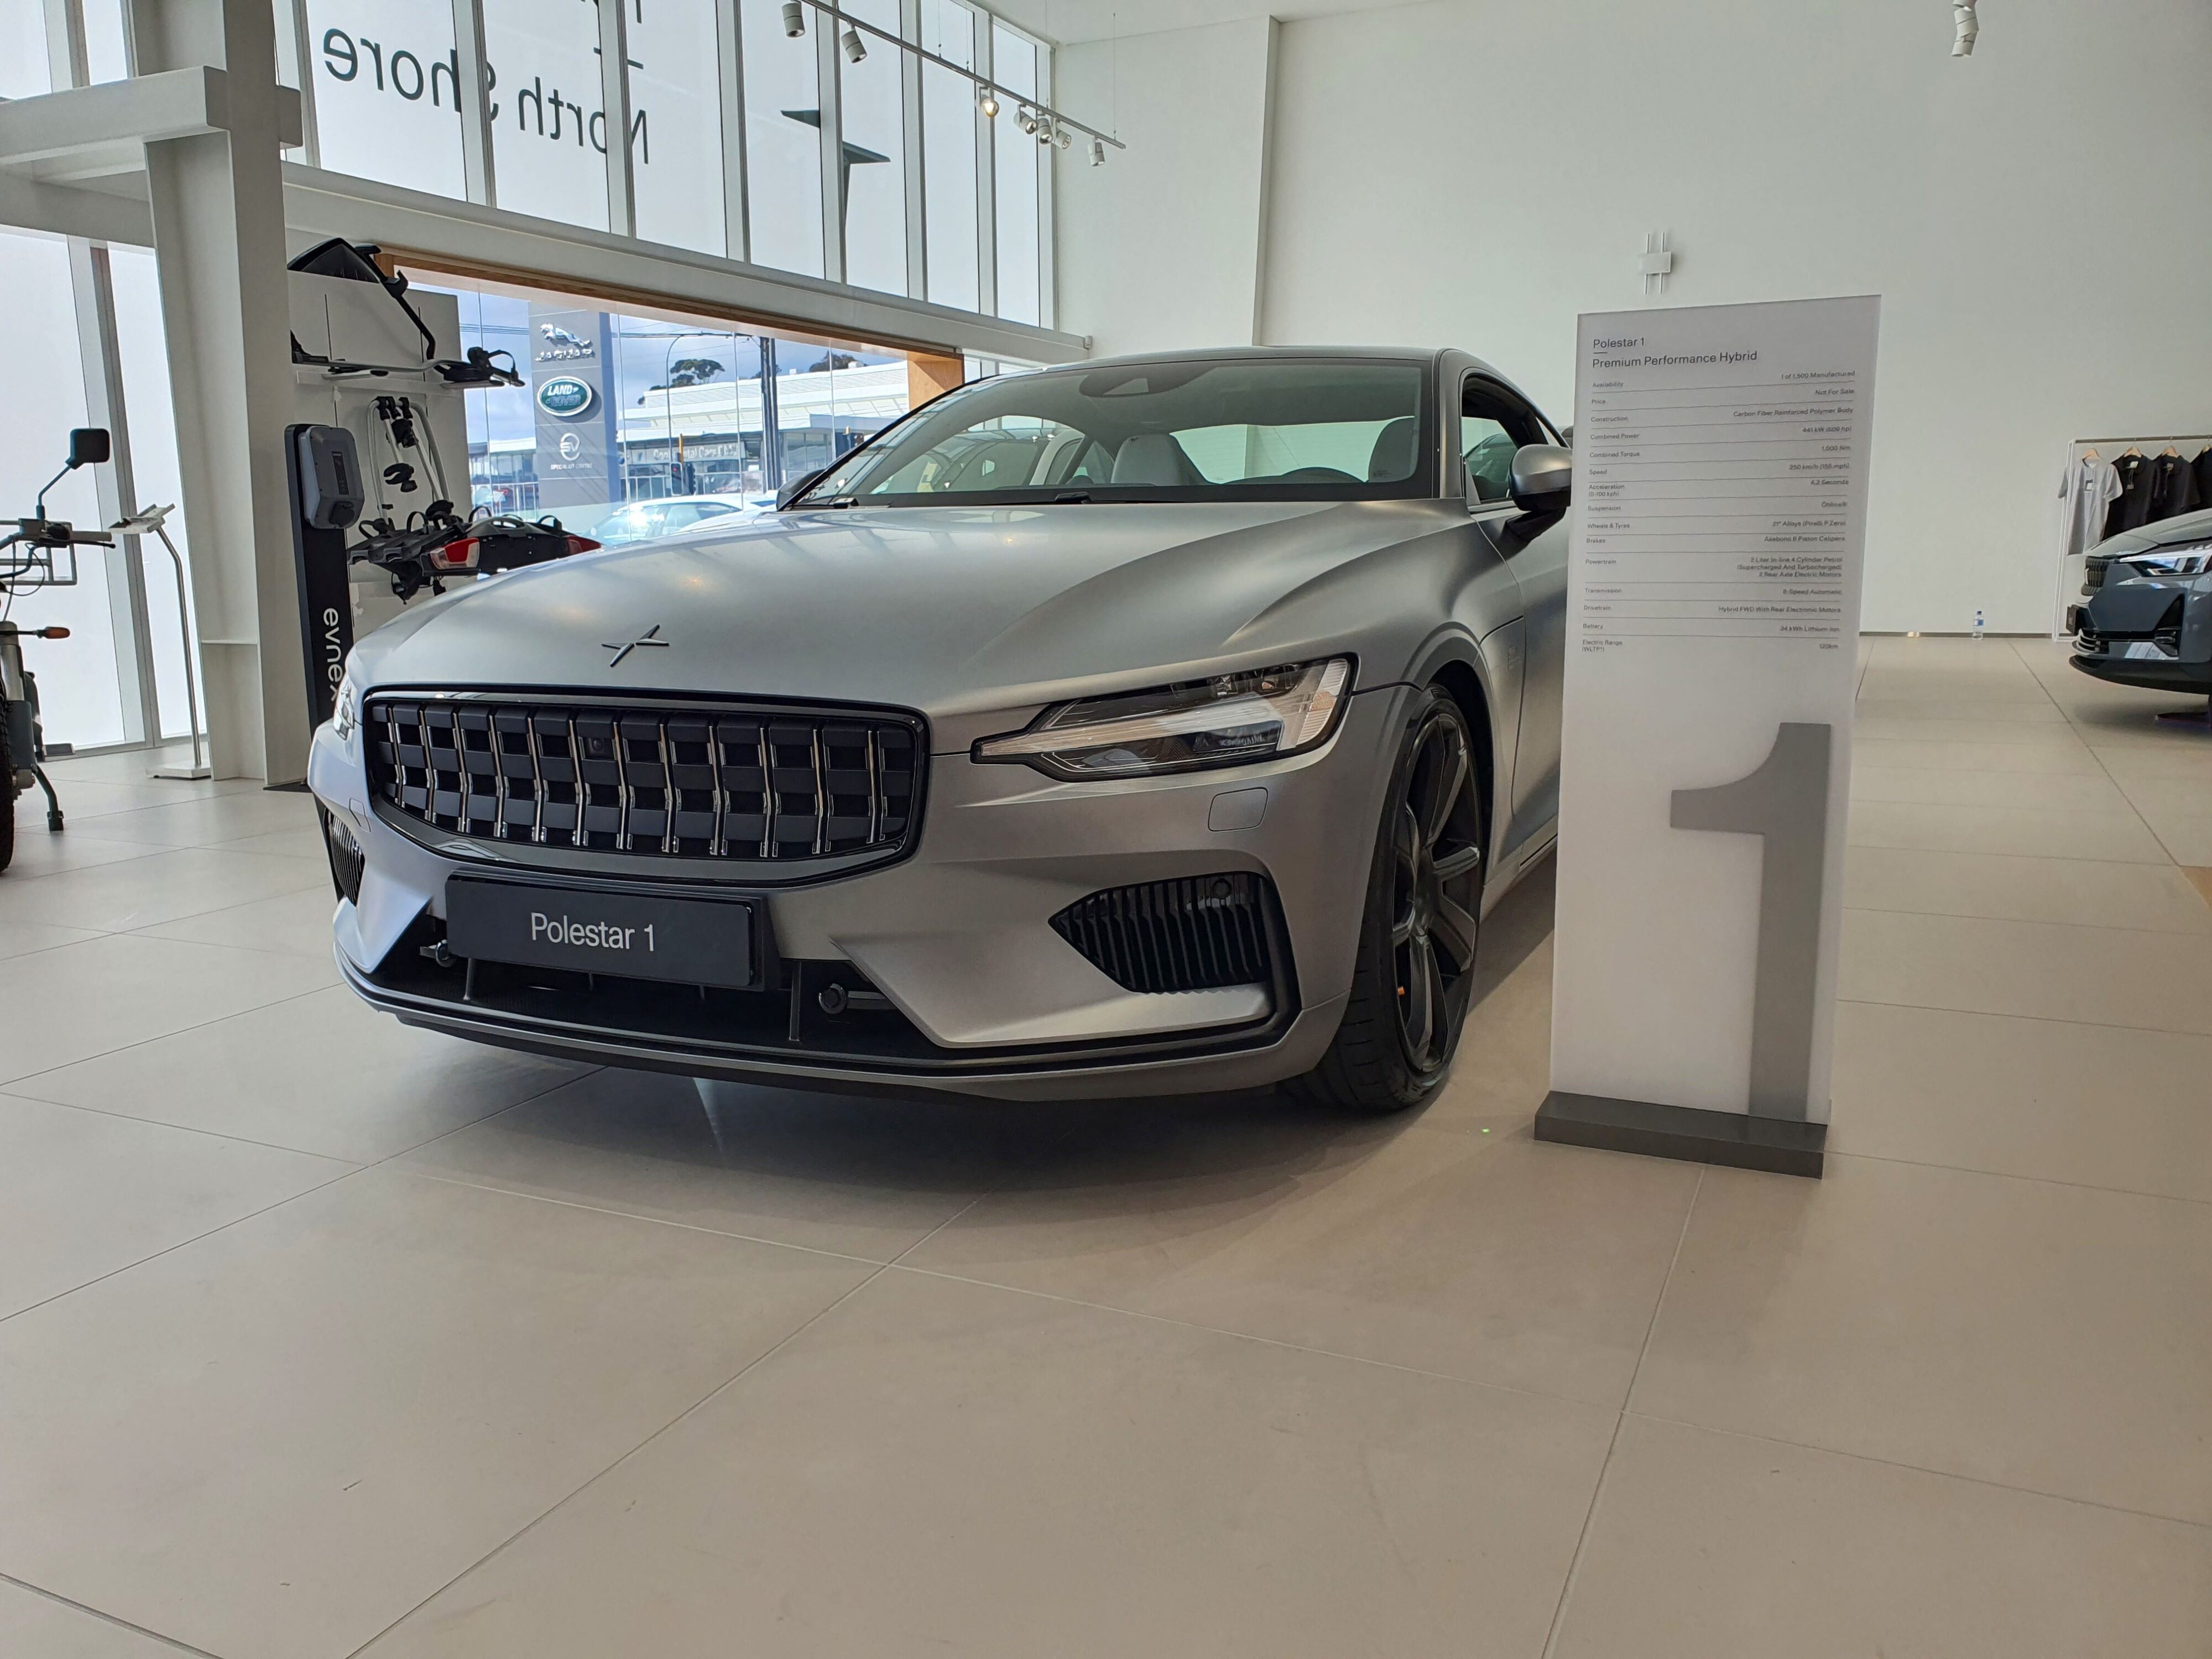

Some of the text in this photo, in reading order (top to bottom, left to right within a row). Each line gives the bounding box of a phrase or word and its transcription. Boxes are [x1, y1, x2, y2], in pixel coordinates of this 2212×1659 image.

[1593, 337, 1645, 349] Polestar 1
[1593, 349, 1757, 368] Premium Performance Hybrid
[1810, 370, 1855, 378] Manufactured
[547, 384, 573, 396] LAND
[550, 394, 581, 407] ROVER
[1670, 722, 1831, 1123] 1
[531, 912, 654, 951] Polestar 1
